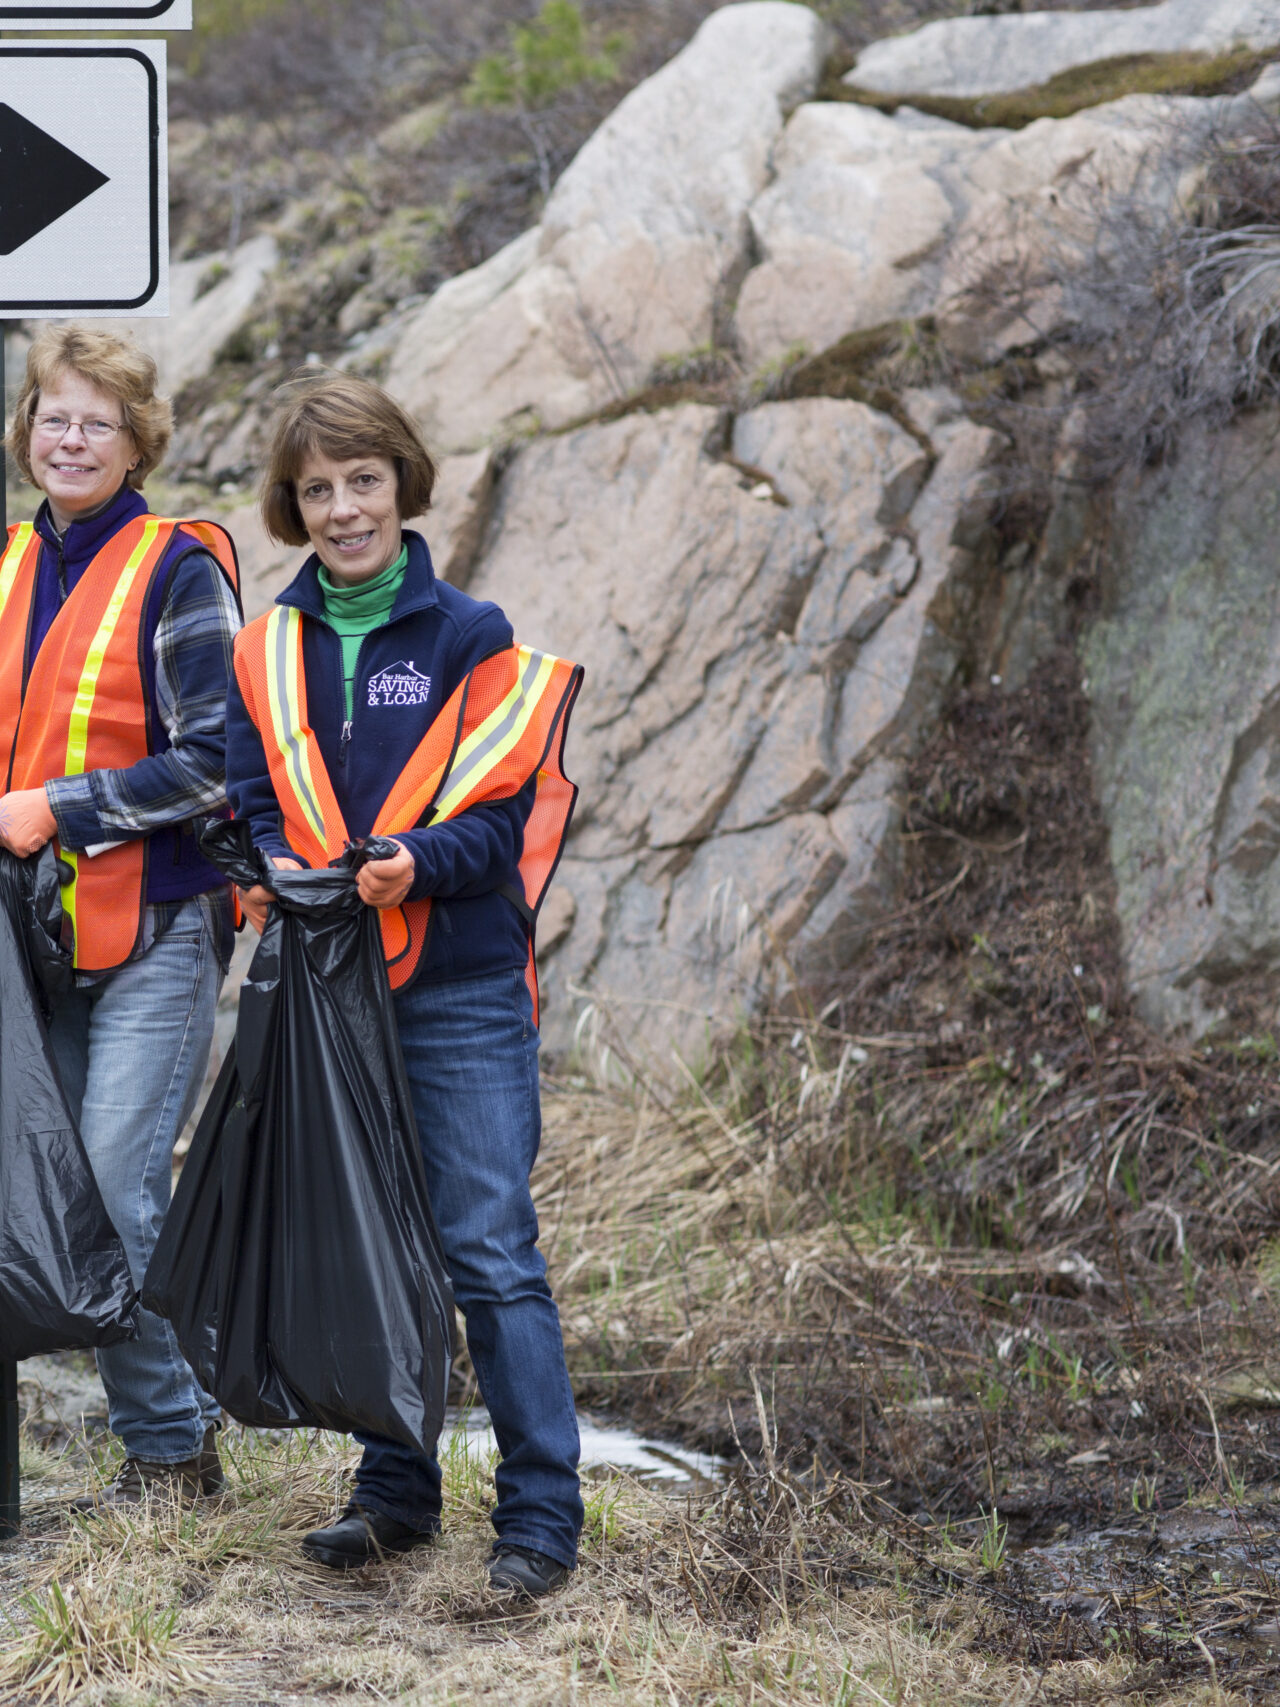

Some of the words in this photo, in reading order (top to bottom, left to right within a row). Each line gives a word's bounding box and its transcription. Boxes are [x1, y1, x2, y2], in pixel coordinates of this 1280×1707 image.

[394, 673, 418, 681] Harbor
[367, 679, 431, 693] SAVINGS
[367, 692, 380, 706] &
[383, 690, 430, 705] LOAN
